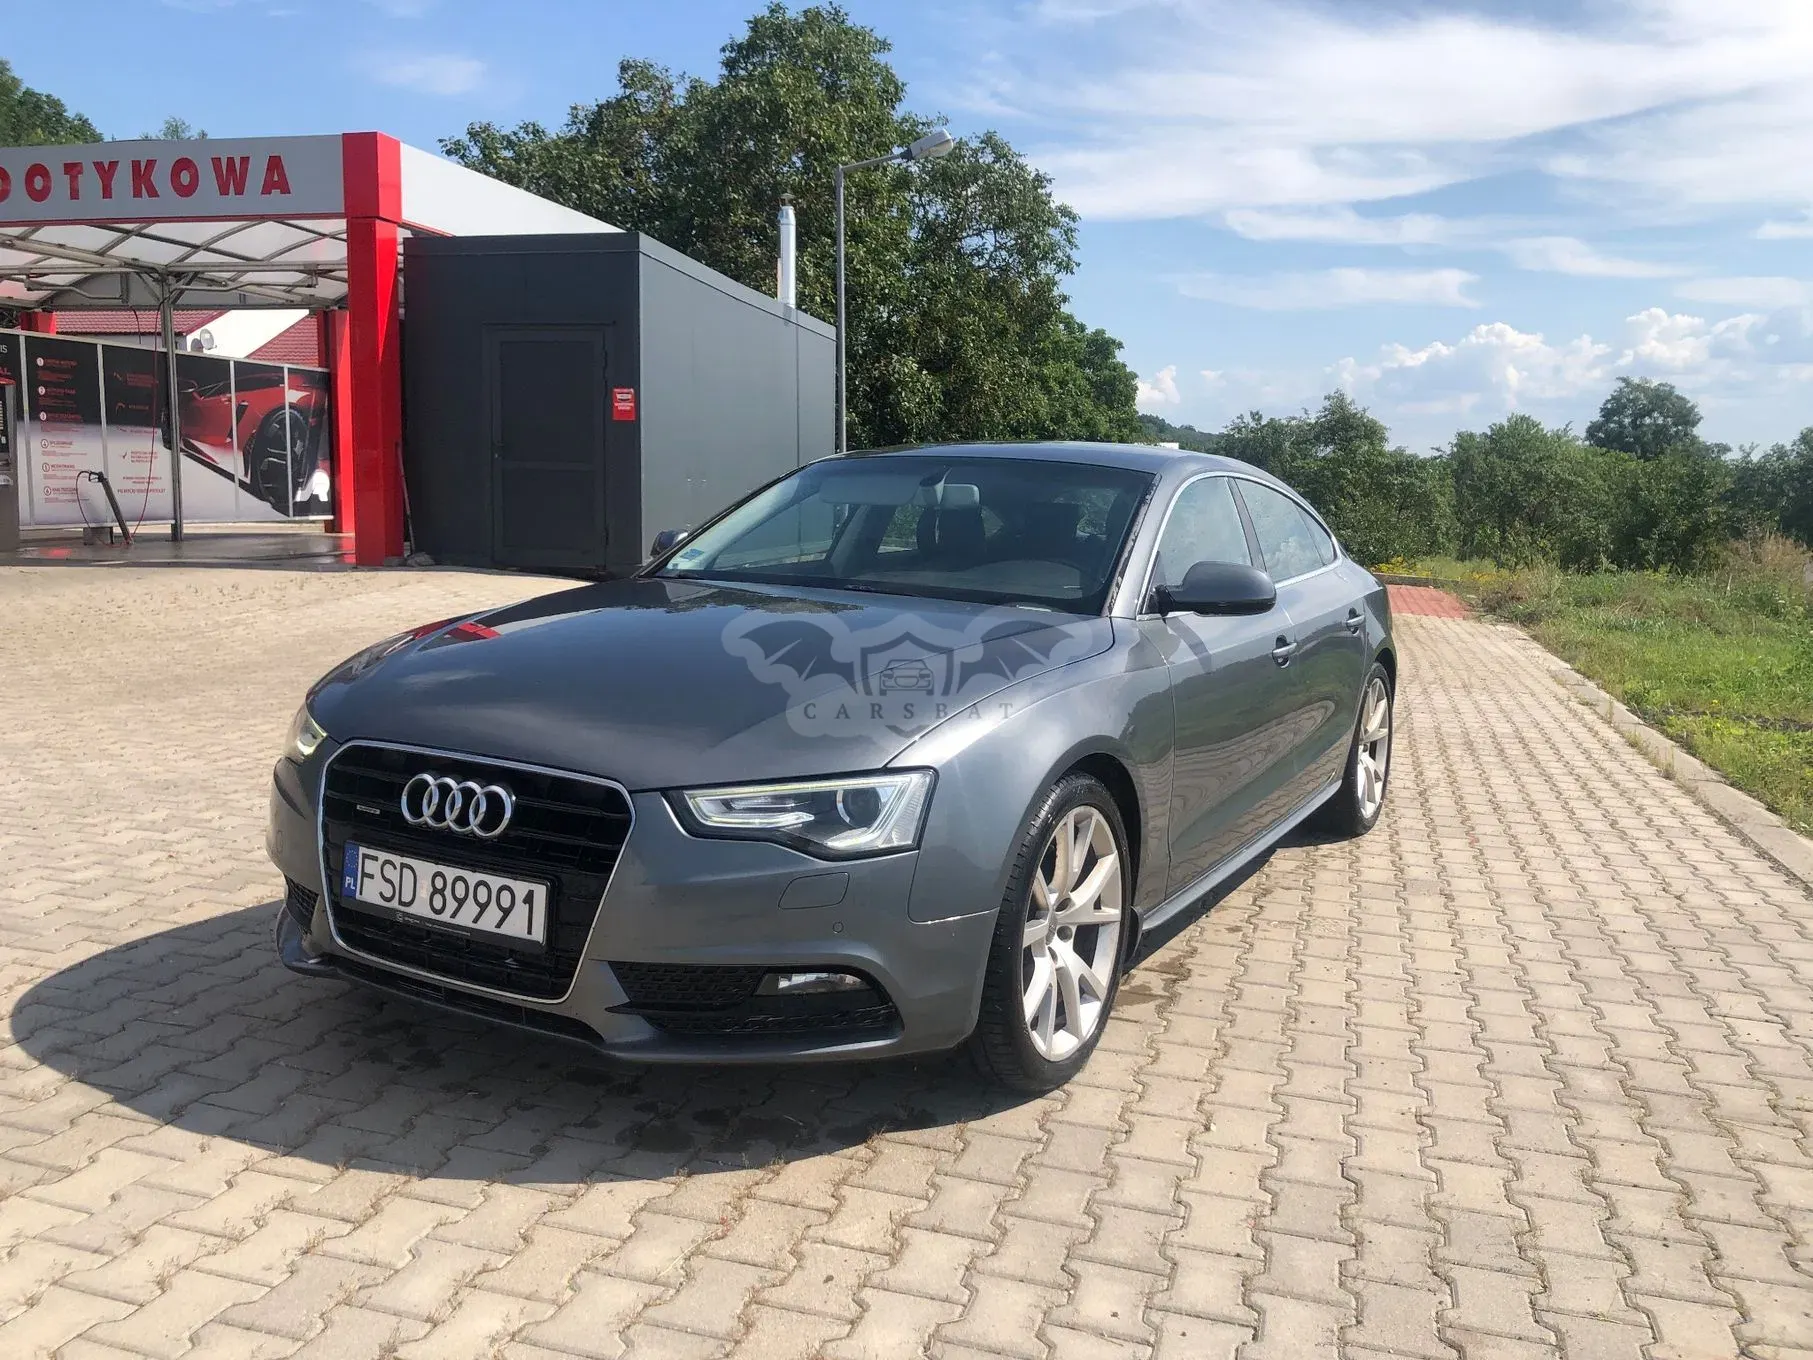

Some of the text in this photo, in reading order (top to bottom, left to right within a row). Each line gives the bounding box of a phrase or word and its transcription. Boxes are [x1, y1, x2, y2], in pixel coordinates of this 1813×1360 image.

[345, 876, 356, 890] PL
[359, 852, 417, 908] FSD
[429, 870, 535, 936] 89991
